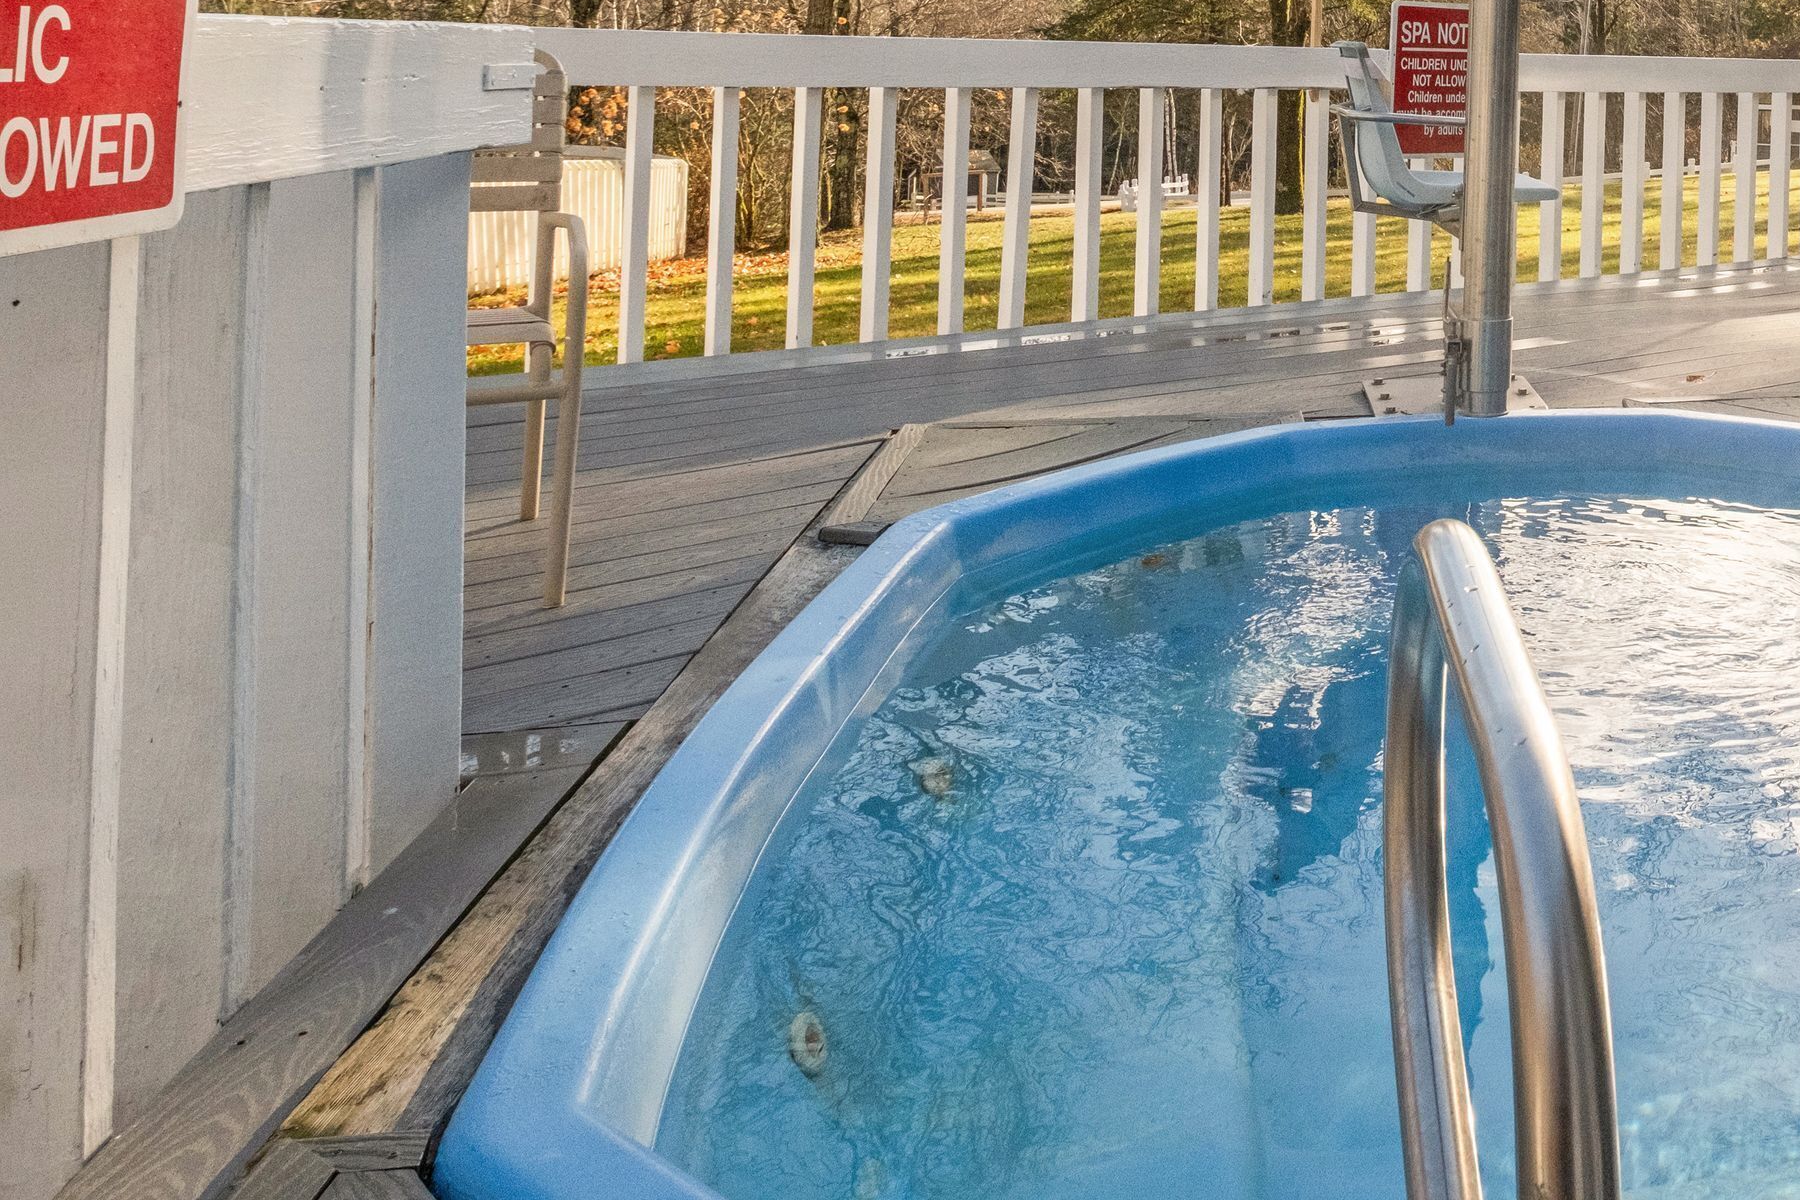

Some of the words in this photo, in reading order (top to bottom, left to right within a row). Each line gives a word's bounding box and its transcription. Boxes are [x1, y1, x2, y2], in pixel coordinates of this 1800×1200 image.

[1401, 20, 1431, 44] SPA
[1400, 57, 1447, 70] CHILDREN
[1412, 74, 1432, 87] NOT
[1408, 90, 1443, 103] Children
[1424, 124, 1434, 138] by
[0, 112, 155, 198] OWED
